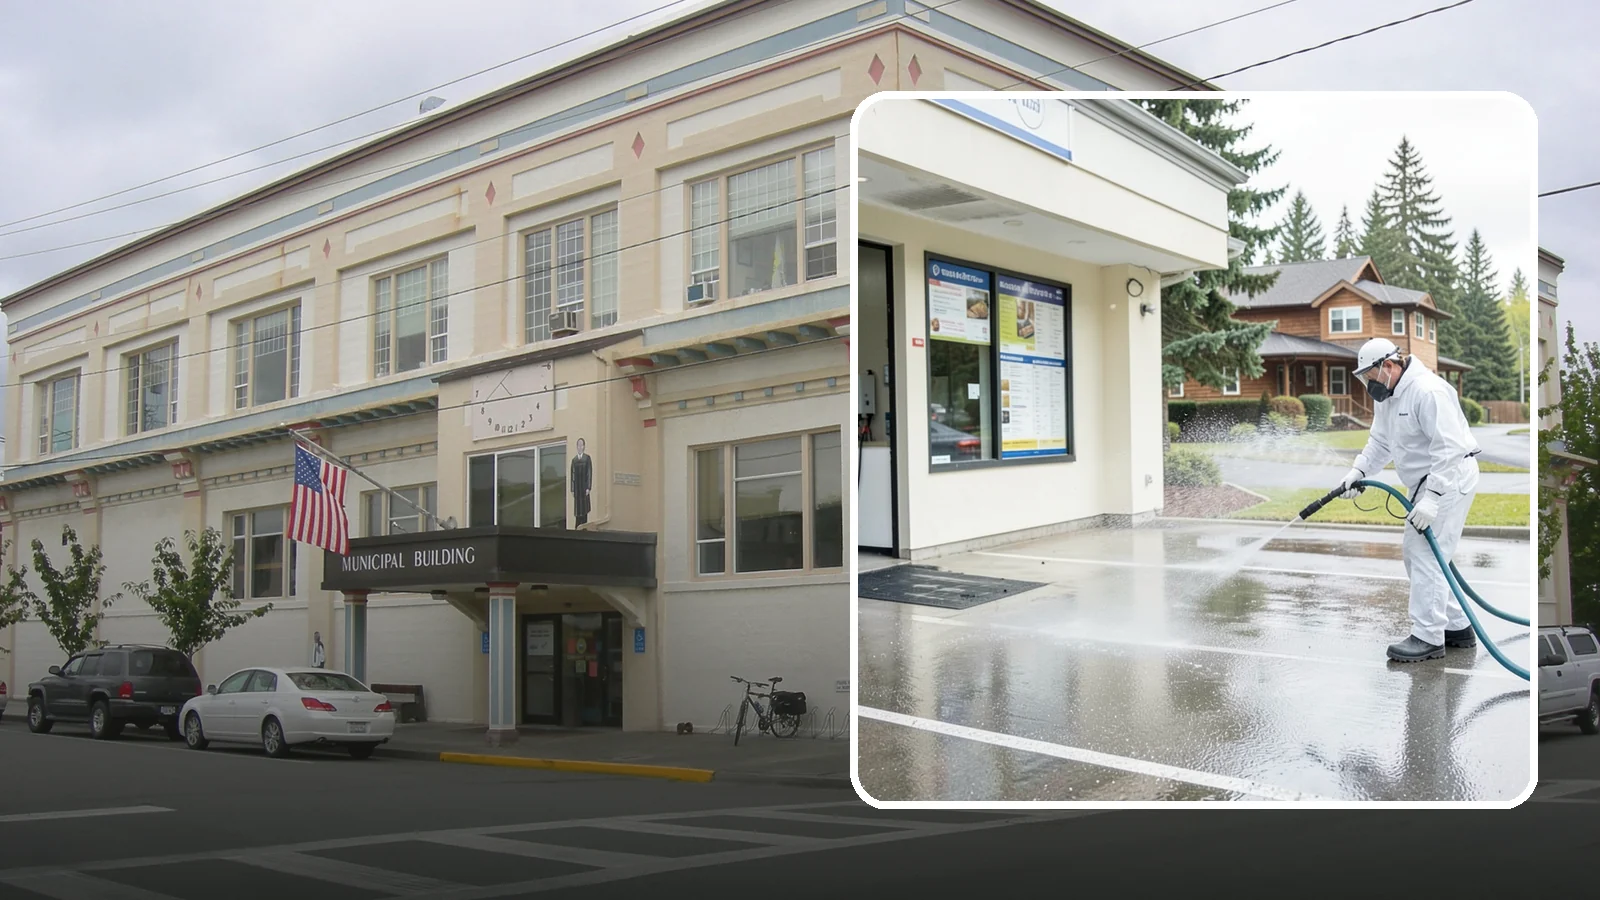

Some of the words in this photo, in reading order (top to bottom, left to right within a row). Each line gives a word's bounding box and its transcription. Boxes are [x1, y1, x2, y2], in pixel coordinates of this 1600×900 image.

[488, 418, 492, 426] 9
[529, 414, 532, 422] 3
[342, 552, 405, 572] MUNICIPAL
[414, 546, 475, 567] BUILDING
